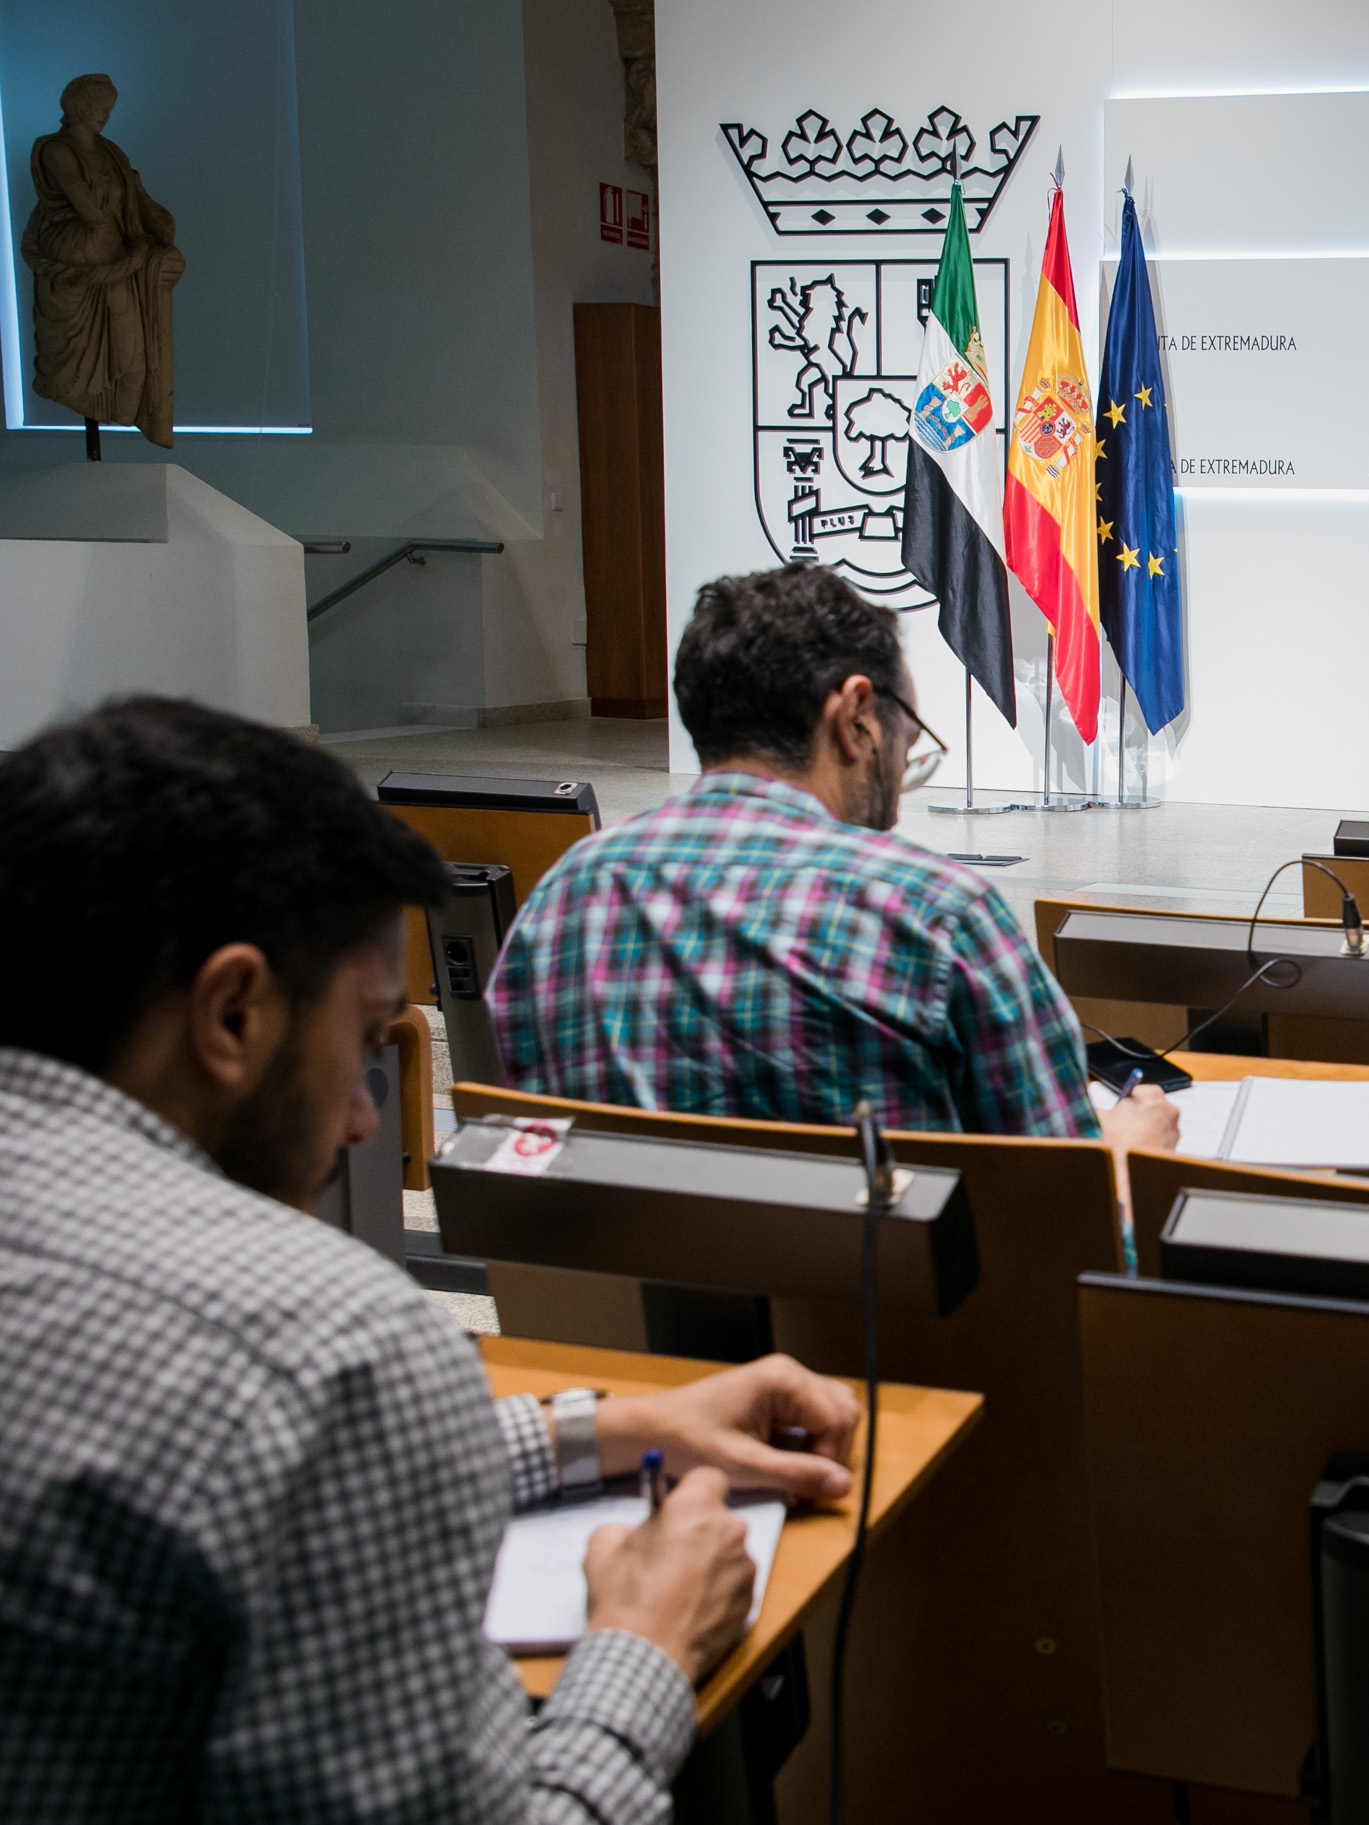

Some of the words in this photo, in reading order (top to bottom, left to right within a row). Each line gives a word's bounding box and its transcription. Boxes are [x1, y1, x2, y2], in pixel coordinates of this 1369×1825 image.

[1181, 335, 1197, 351] DE
[1201, 335, 1297, 351] EXTREMADURA
[1180, 458, 1196, 474] DE
[1200, 458, 1296, 475] EXTREMADURA
[820, 515, 855, 529] PLUS
